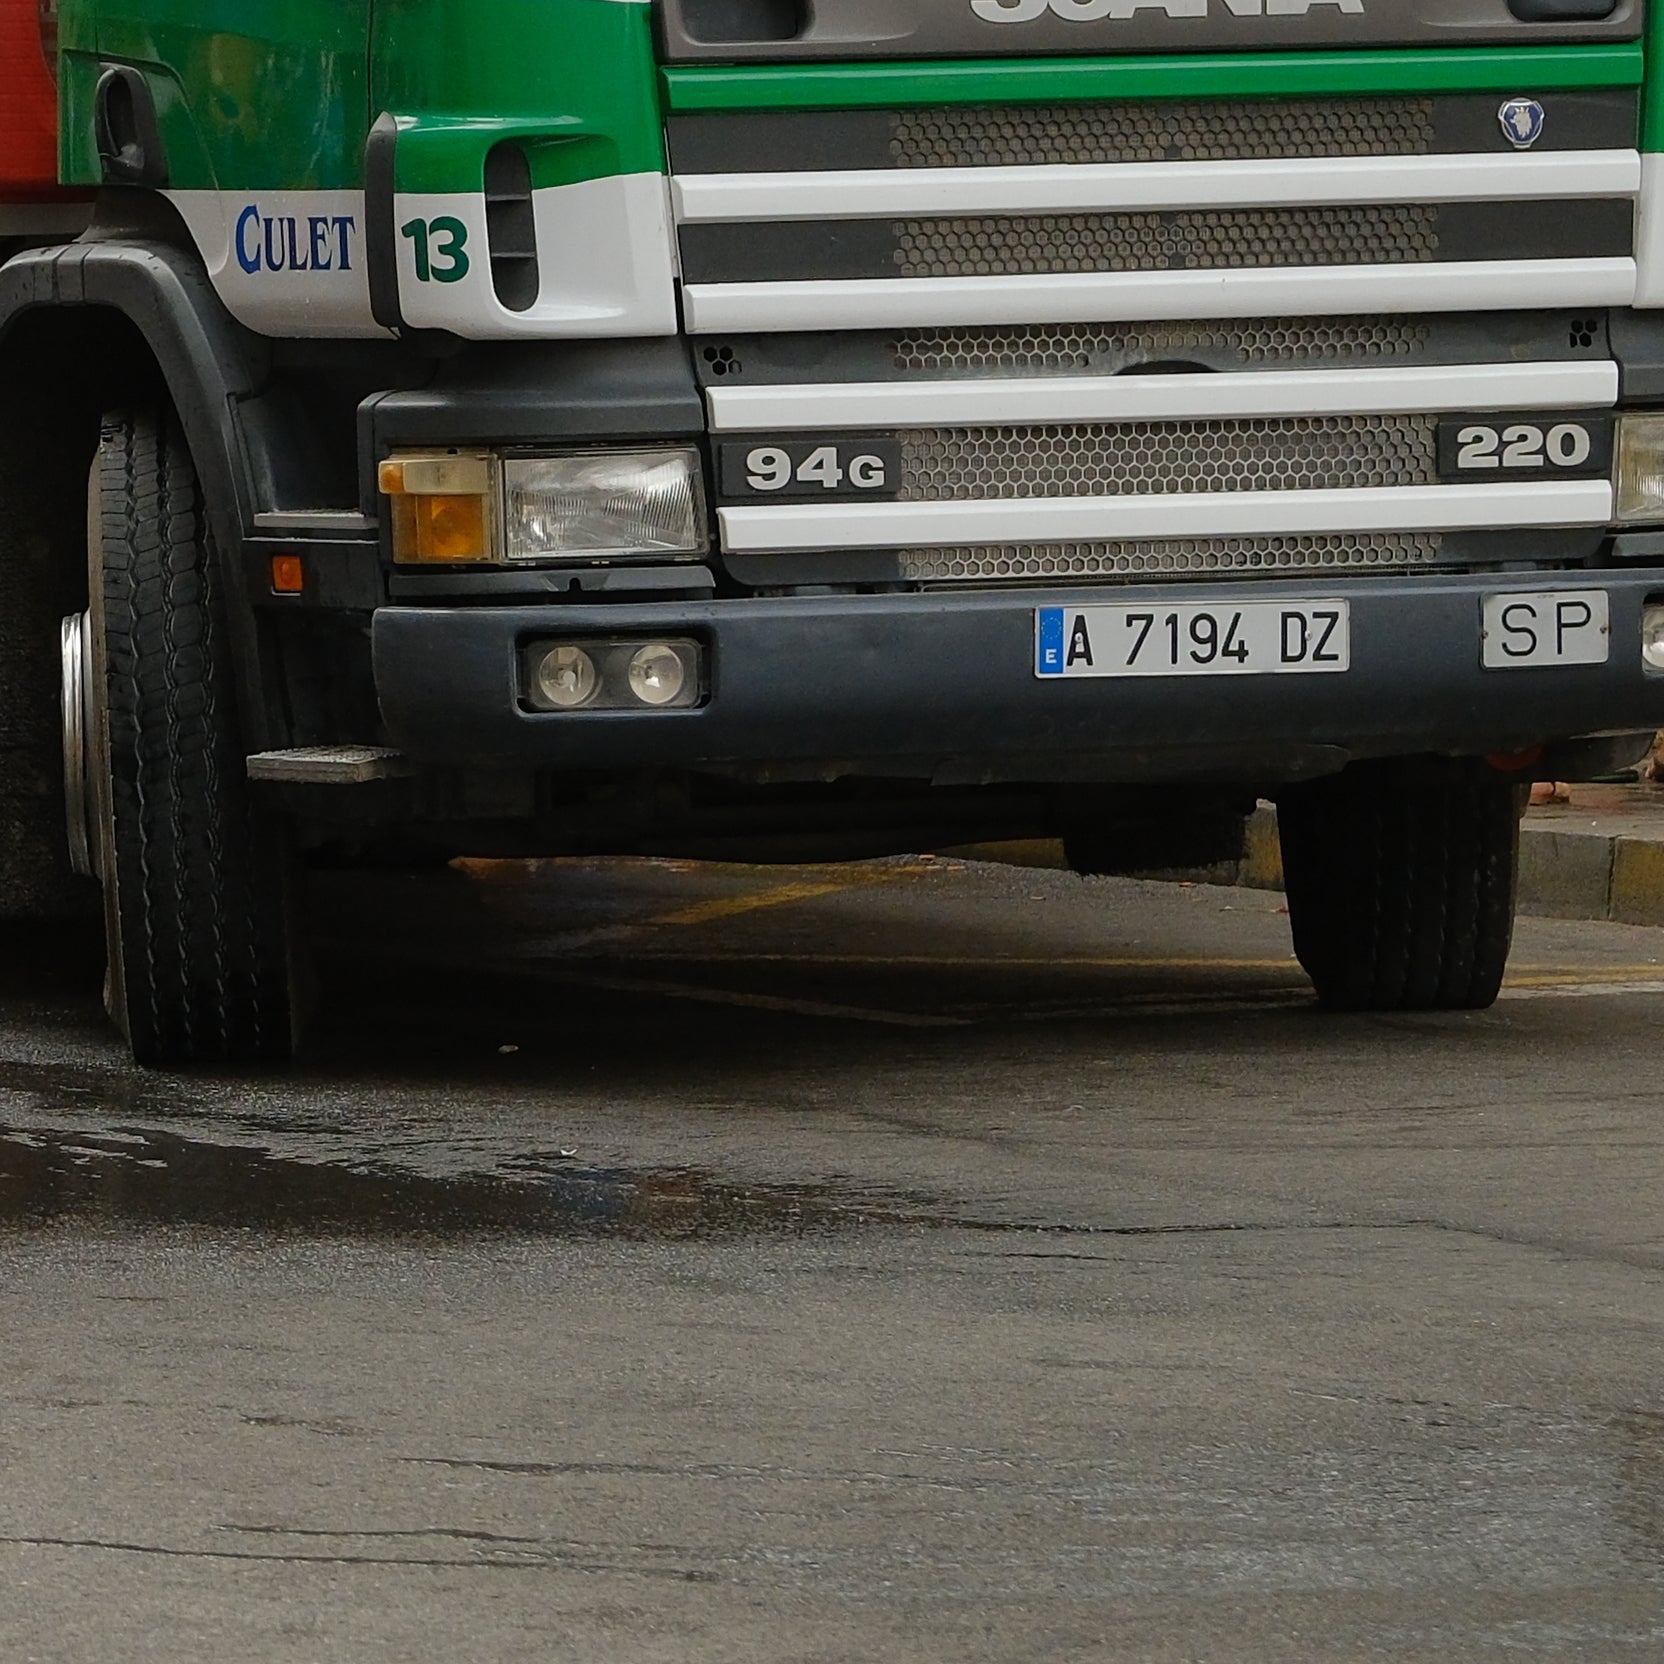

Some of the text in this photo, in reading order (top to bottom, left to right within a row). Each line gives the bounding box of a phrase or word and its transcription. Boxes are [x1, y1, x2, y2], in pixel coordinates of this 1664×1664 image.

[235, 204, 356, 275] CULET
[401, 216, 470, 283] 13
[1457, 423, 1590, 468] 220
[1045, 610, 1339, 666] E A 7194 DZ
